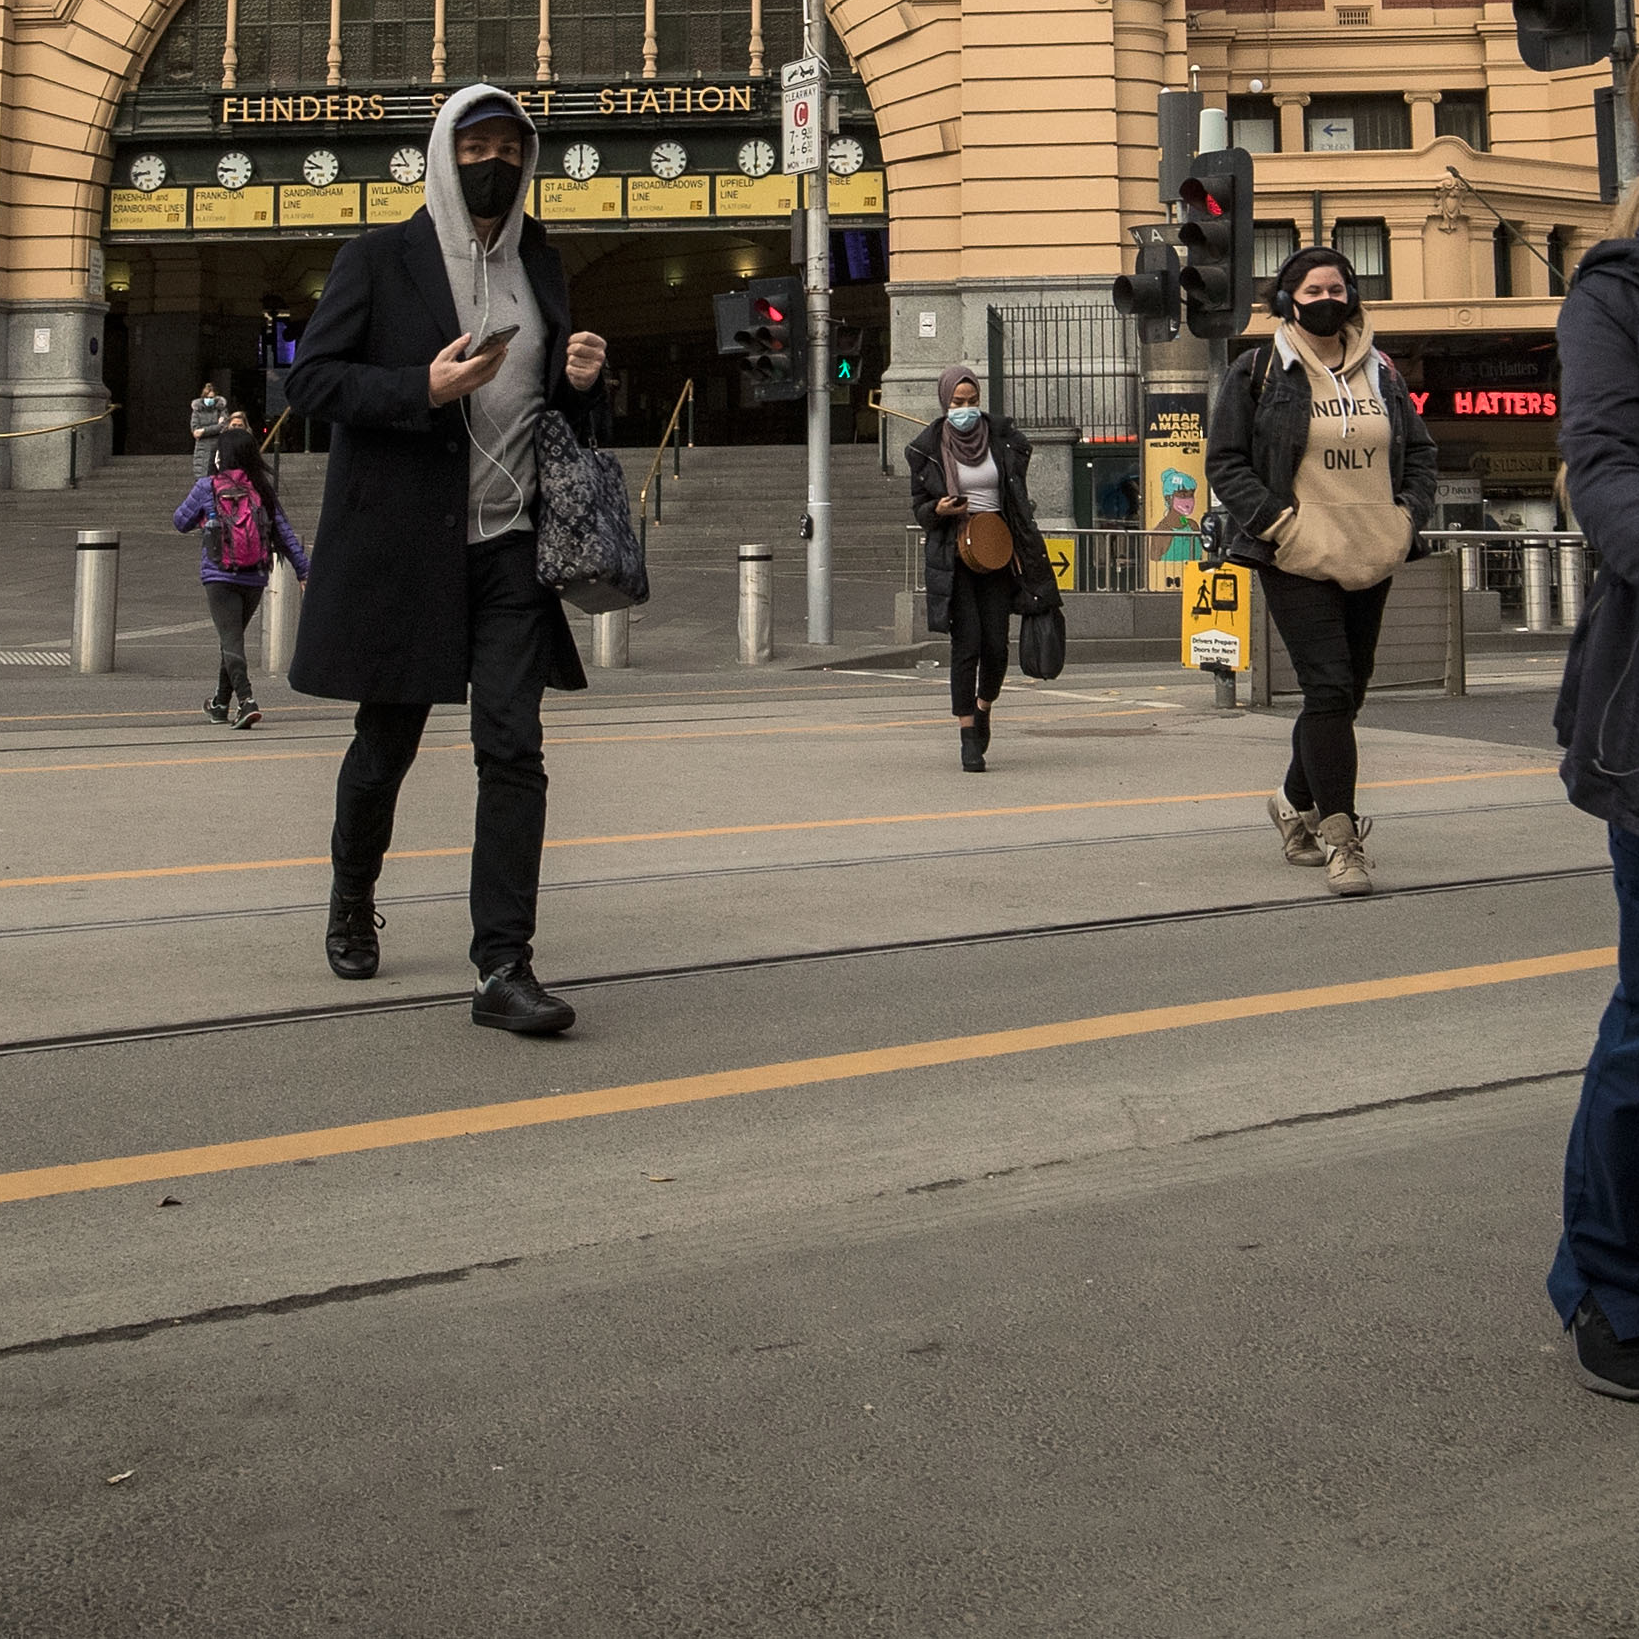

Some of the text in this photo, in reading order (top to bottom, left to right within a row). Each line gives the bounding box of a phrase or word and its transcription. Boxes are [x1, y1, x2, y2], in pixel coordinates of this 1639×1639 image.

[785, 87, 817, 103] CLEARWAY
[222, 85, 751, 123] FLINDERS SET STATION
[545, 181, 589, 192] ST ALBANS
[631, 179, 703, 190] BROADMEADOWS
[720, 178, 754, 188] UPFIELD
[195, 190, 244, 200] FRANKSTON
[283, 187, 344, 198] SANDRINGHAM
[371, 185, 426, 195] WILLIAMSTOW
[720, 190, 739, 199] LINE
[113, 193, 169, 202] PAKENHAM and
[370, 197, 389, 207] LINE
[544, 193, 563, 203] LINE
[631, 192, 651, 202] LINE
[112, 203, 185, 213] CRANBOURNE LINES
[195, 202, 214, 212] LINE
[283, 200, 301, 210] LINE
[1311, 398, 1388, 418] INDNES
[1455, 391, 1557, 416] HATTERS
[1157, 413, 1200, 422] WEAR
[1150, 422, 1200, 431] A MASK
[1170, 430, 1200, 439] AND
[1324, 447, 1376, 470] ONLY
[1192, 637, 1238, 647] Drivers Prepare
[1216, 656, 1230, 664] Stop
